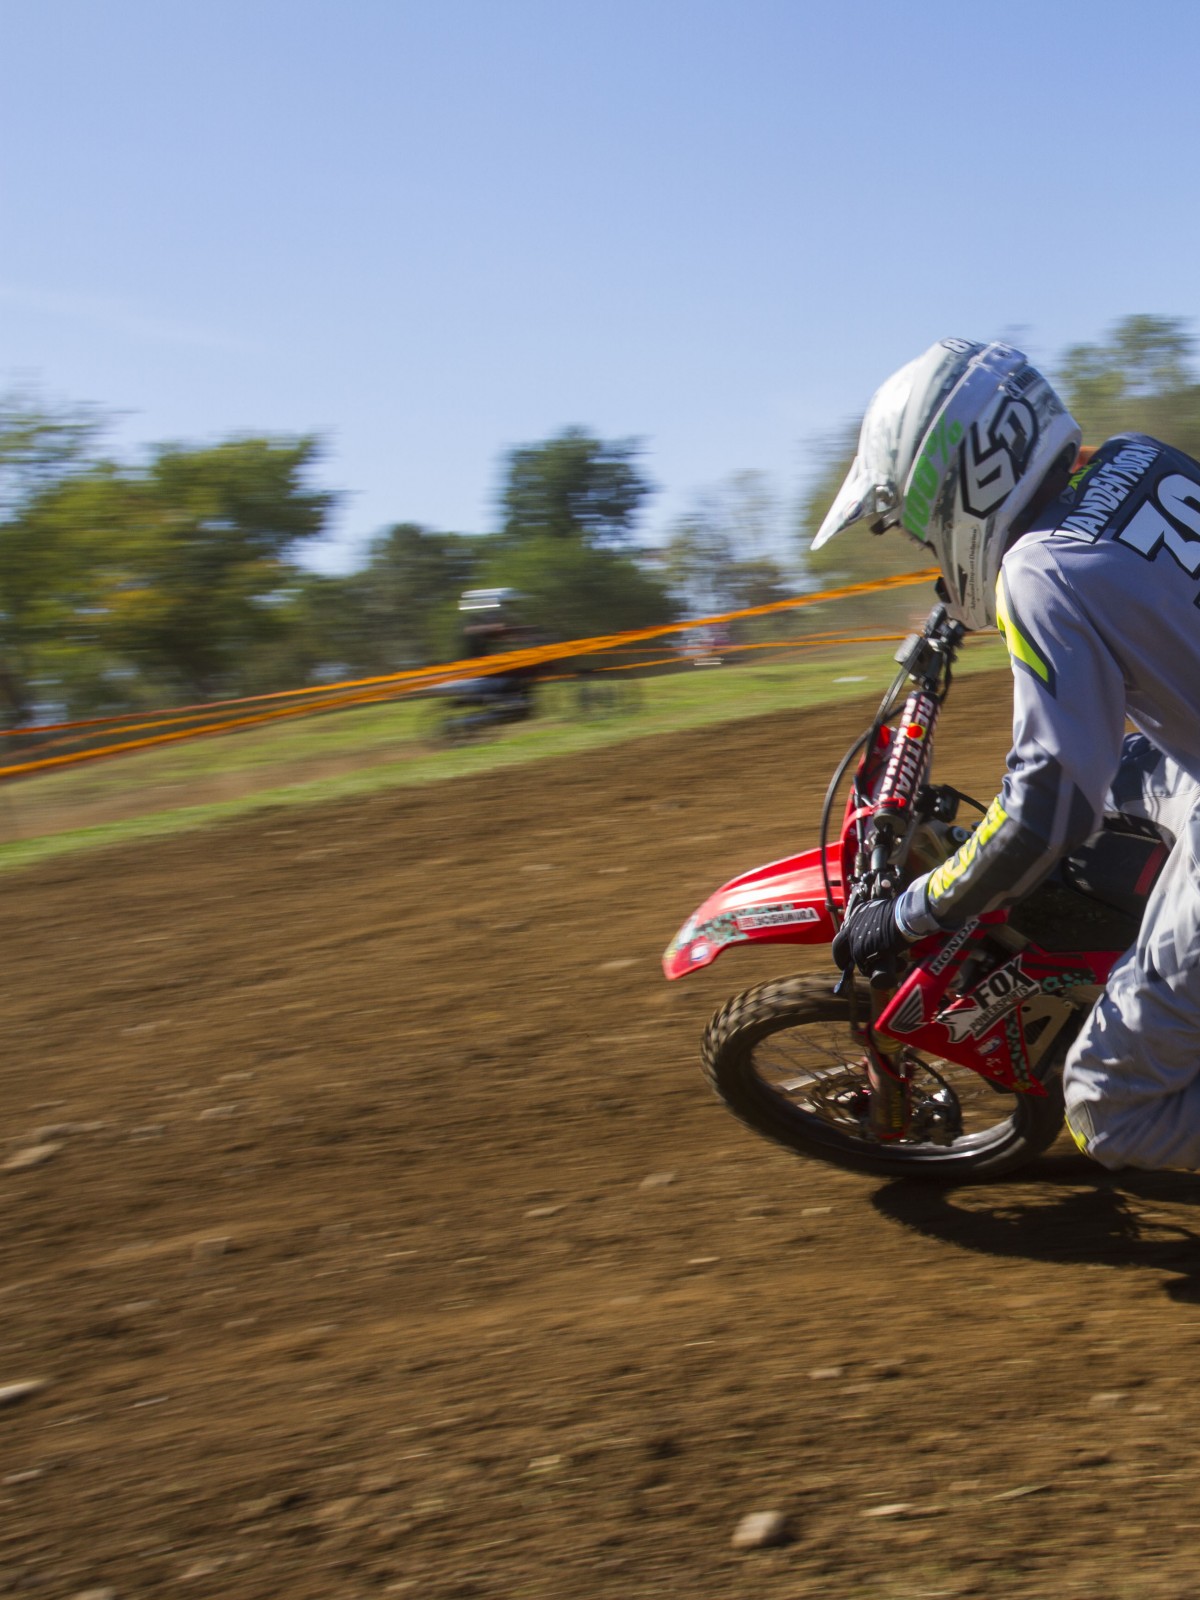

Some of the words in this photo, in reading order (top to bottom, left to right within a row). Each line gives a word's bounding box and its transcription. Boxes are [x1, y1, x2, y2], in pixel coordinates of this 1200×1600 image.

[930, 919, 979, 975] HONDA
[969, 984, 1029, 1032] POWERSPORTS
[975, 955, 1036, 1010] FOX
